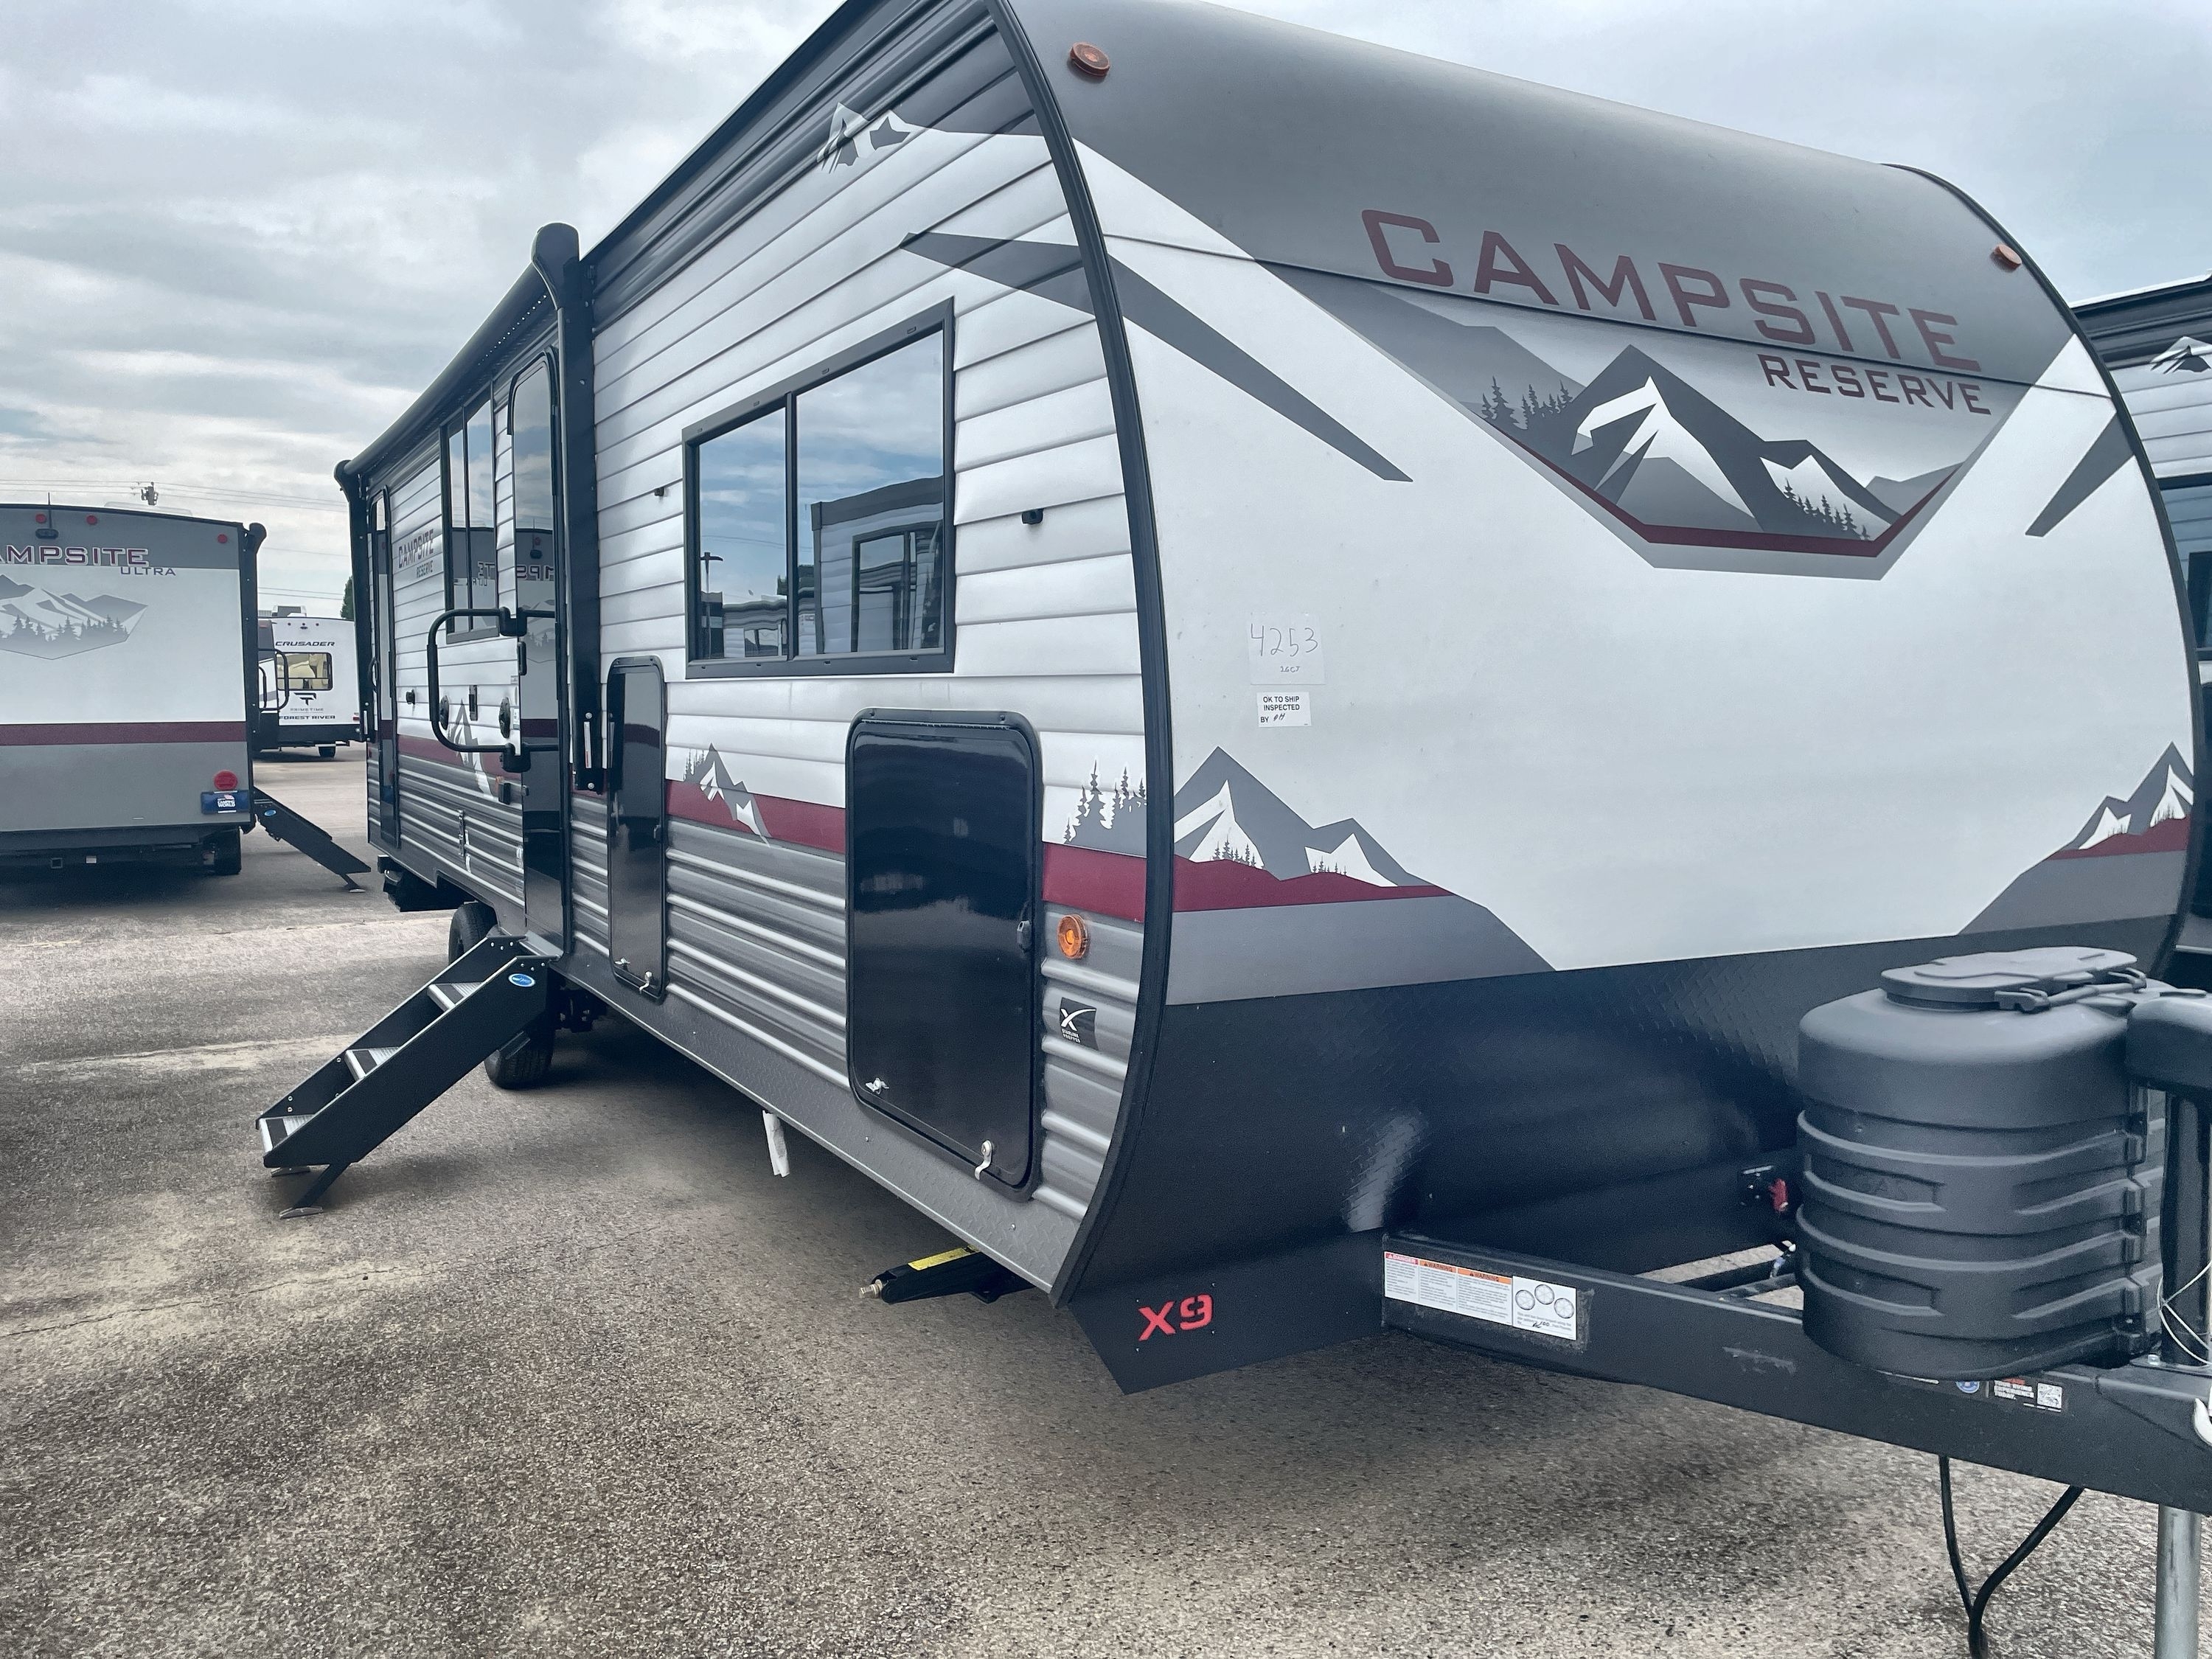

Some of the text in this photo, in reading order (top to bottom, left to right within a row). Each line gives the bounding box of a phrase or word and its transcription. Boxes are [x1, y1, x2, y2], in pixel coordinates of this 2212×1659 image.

[1362, 209, 1981, 372] CAMPSITE
[1757, 354, 1991, 415] RESERVE
[0, 545, 148, 566] MPSITE
[399, 529, 434, 568] CAMPSITE
[121, 567, 175, 575] ULTRA
[417, 560, 433, 578] RESERVE
[1251, 623, 1318, 656] 4253
[1427, 1262, 1453, 1273] WARNING
[1475, 1272, 1499, 1282] WARNING
[1138, 1293, 1213, 1341] X9
